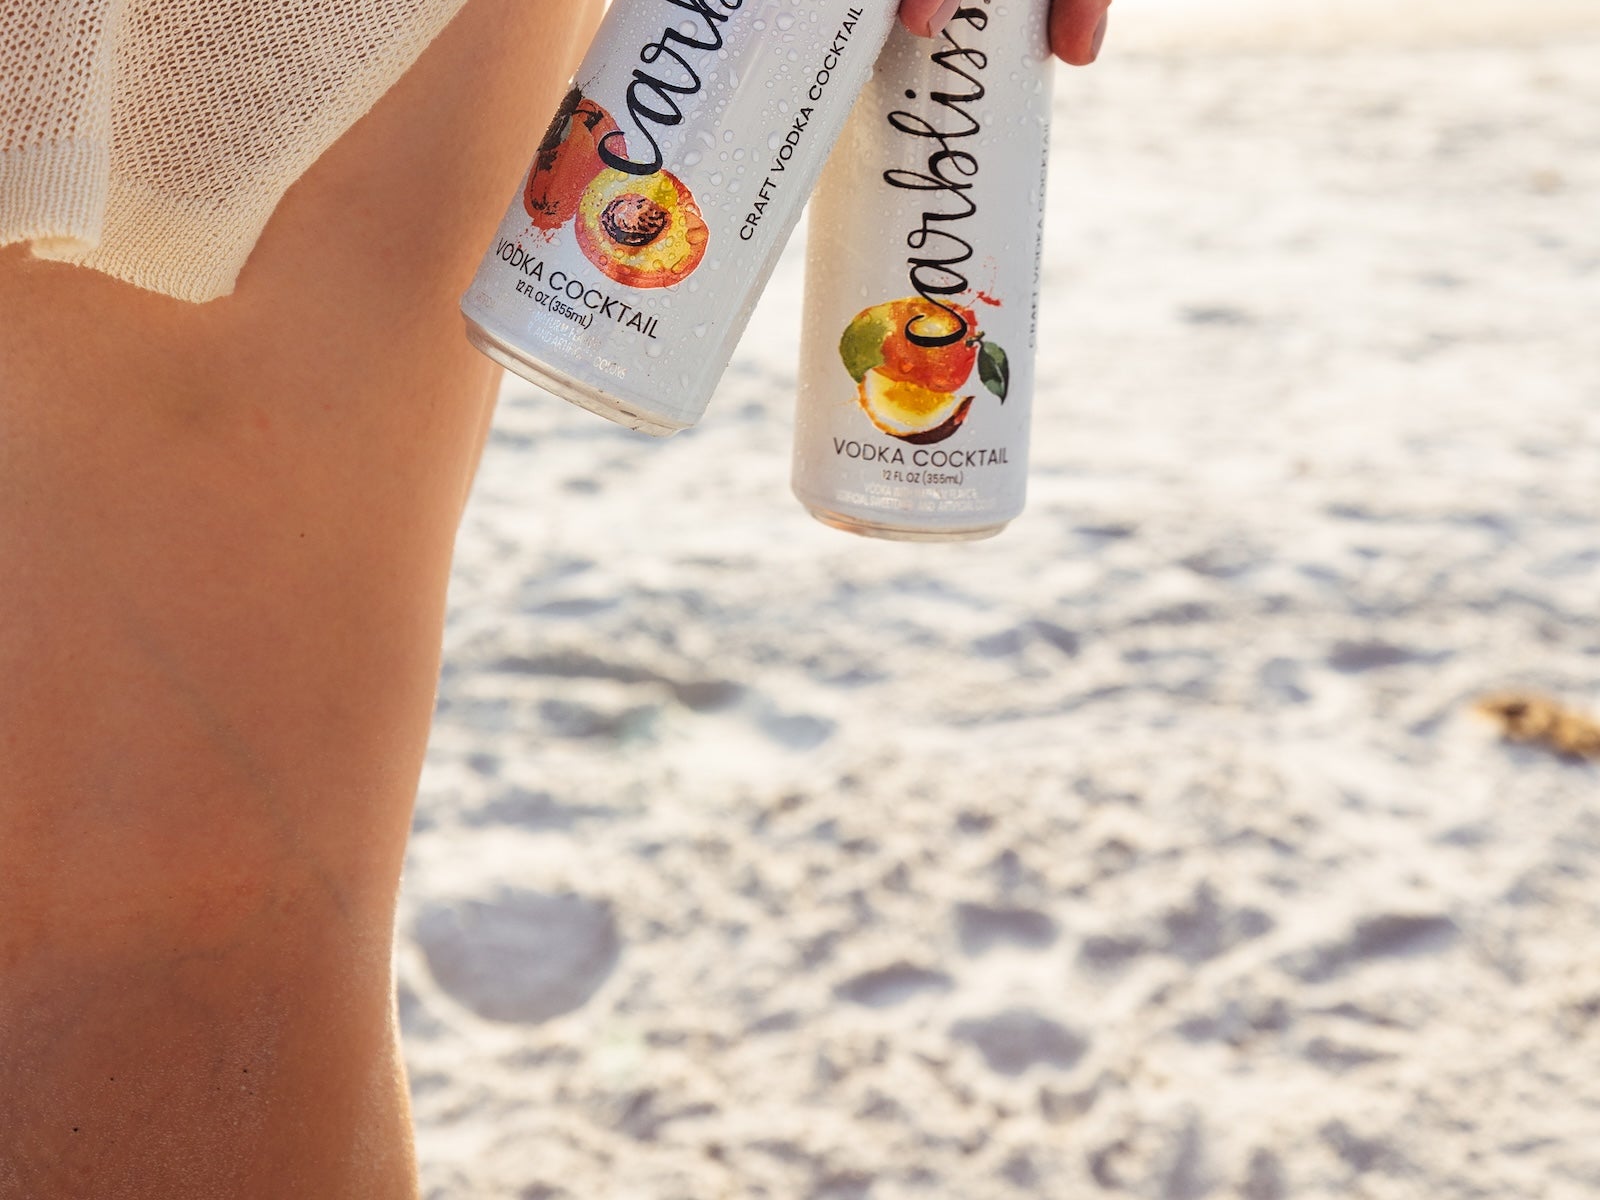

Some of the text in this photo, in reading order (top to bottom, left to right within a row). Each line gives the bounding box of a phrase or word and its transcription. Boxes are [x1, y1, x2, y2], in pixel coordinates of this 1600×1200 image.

[739, 7, 864, 241] CRAFT VODKA COCKTAIL
[495, 237, 545, 282] VODKA
[549, 270, 660, 340] COCKTAIL
[515, 279, 594, 330] 12 FL OZ (355mL)
[832, 437, 1009, 468] VODKA COCKTAIL
[882, 469, 892, 481] 12
[893, 470, 904, 483] FL
[906, 471, 921, 484] OZ
